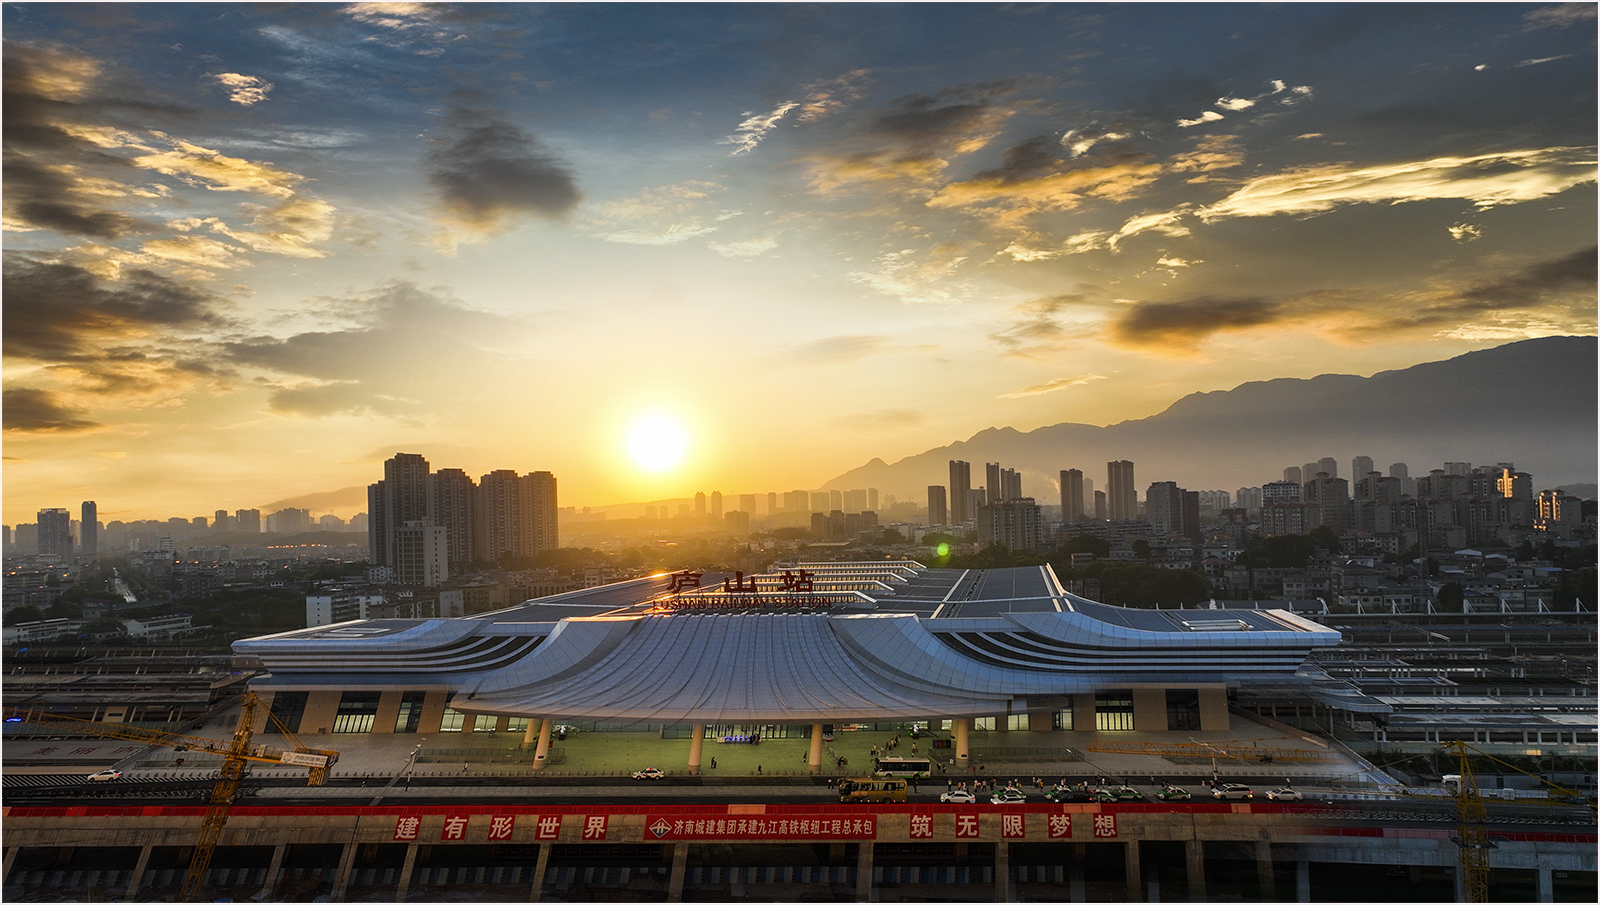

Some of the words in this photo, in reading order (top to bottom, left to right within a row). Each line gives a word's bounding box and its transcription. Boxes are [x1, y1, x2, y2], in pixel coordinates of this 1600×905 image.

[666, 569, 815, 594] 庐山站
[652, 600, 707, 610] LUSHAN
[711, 599, 769, 609] RAILWAY
[774, 598, 831, 608] STATION
[394, 816, 606, 839] 建有形世界
[673, 818, 873, 835] 济南城建集团承建九江高铁枢纽工程总承包
[911, 815, 1116, 837] 筑无限梦想
